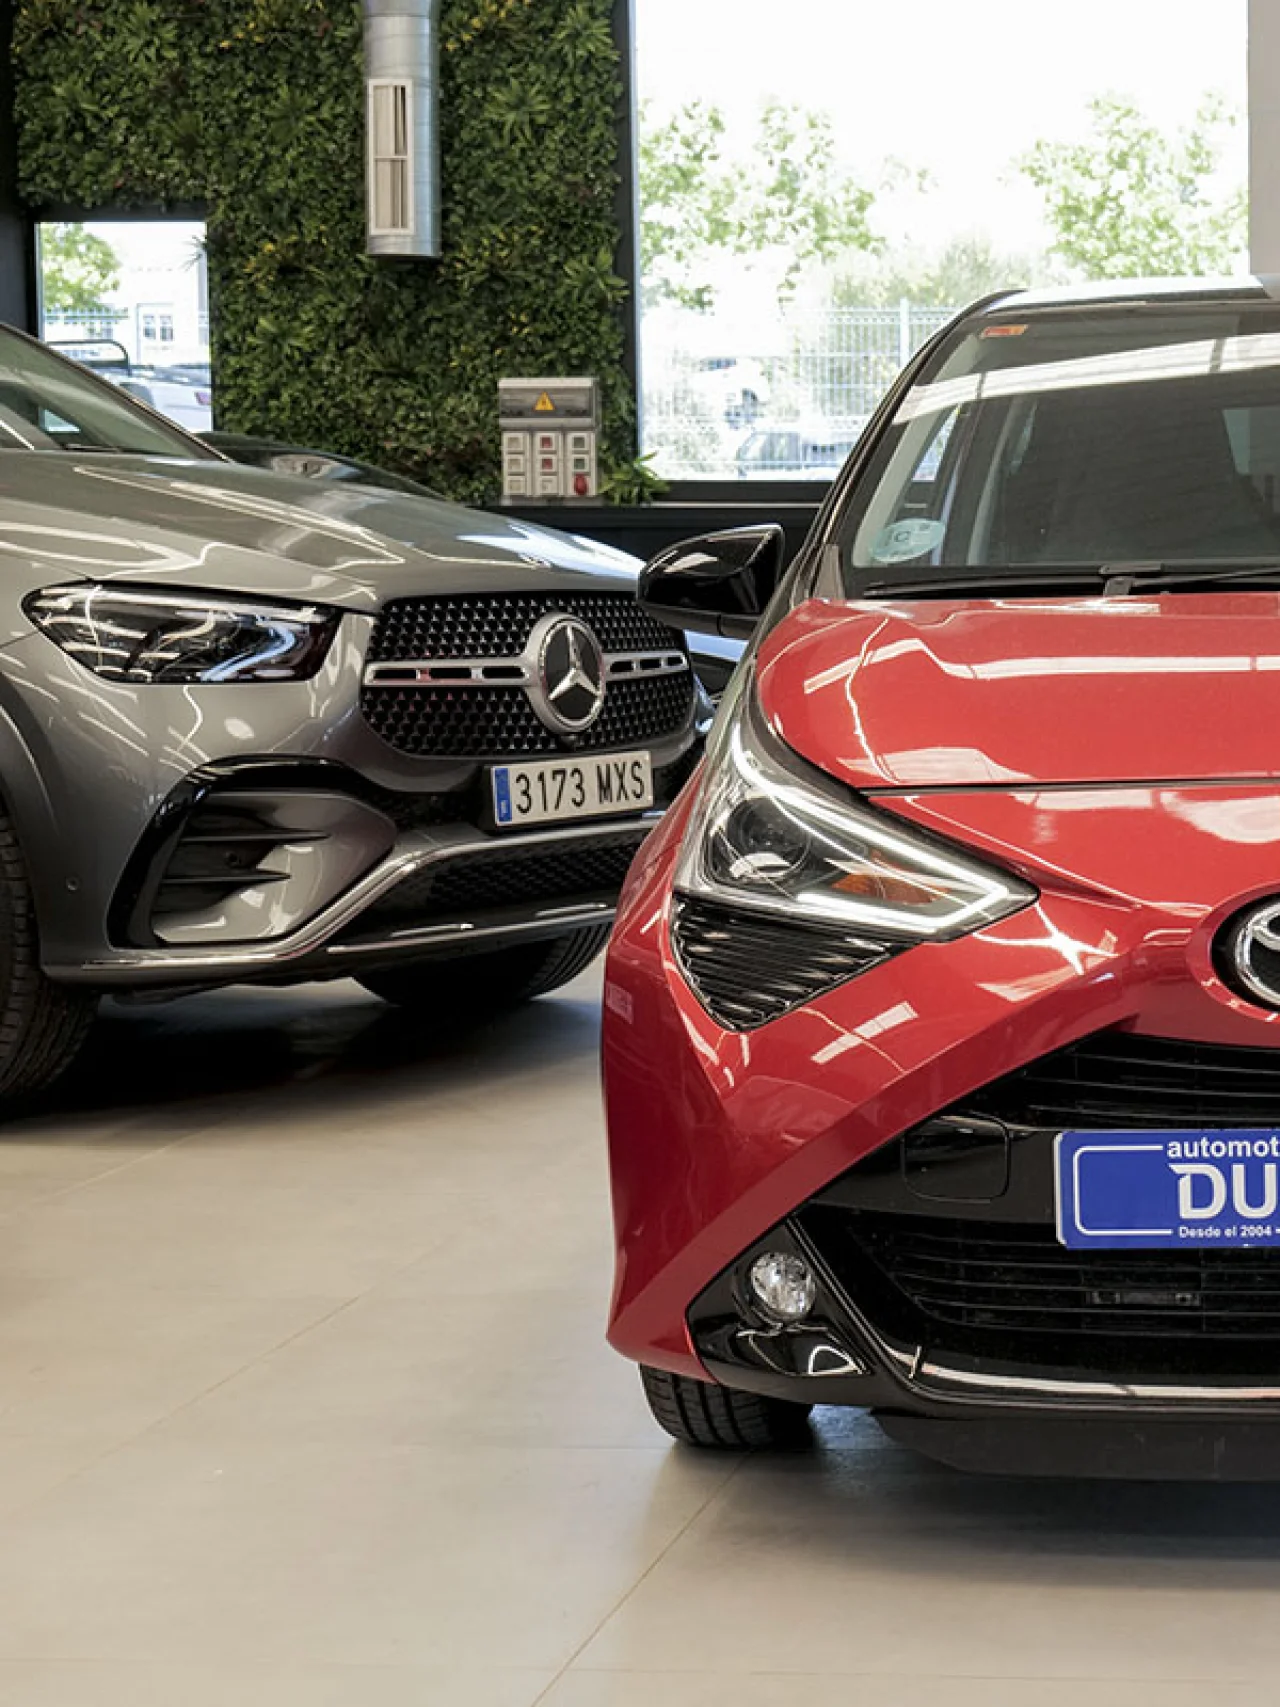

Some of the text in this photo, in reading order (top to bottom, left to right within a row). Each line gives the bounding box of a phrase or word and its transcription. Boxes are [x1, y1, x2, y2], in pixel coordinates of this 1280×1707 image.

[515, 760, 645, 814] 3173 MXS
[1179, 1226, 1272, 1238] Desde el 2004
